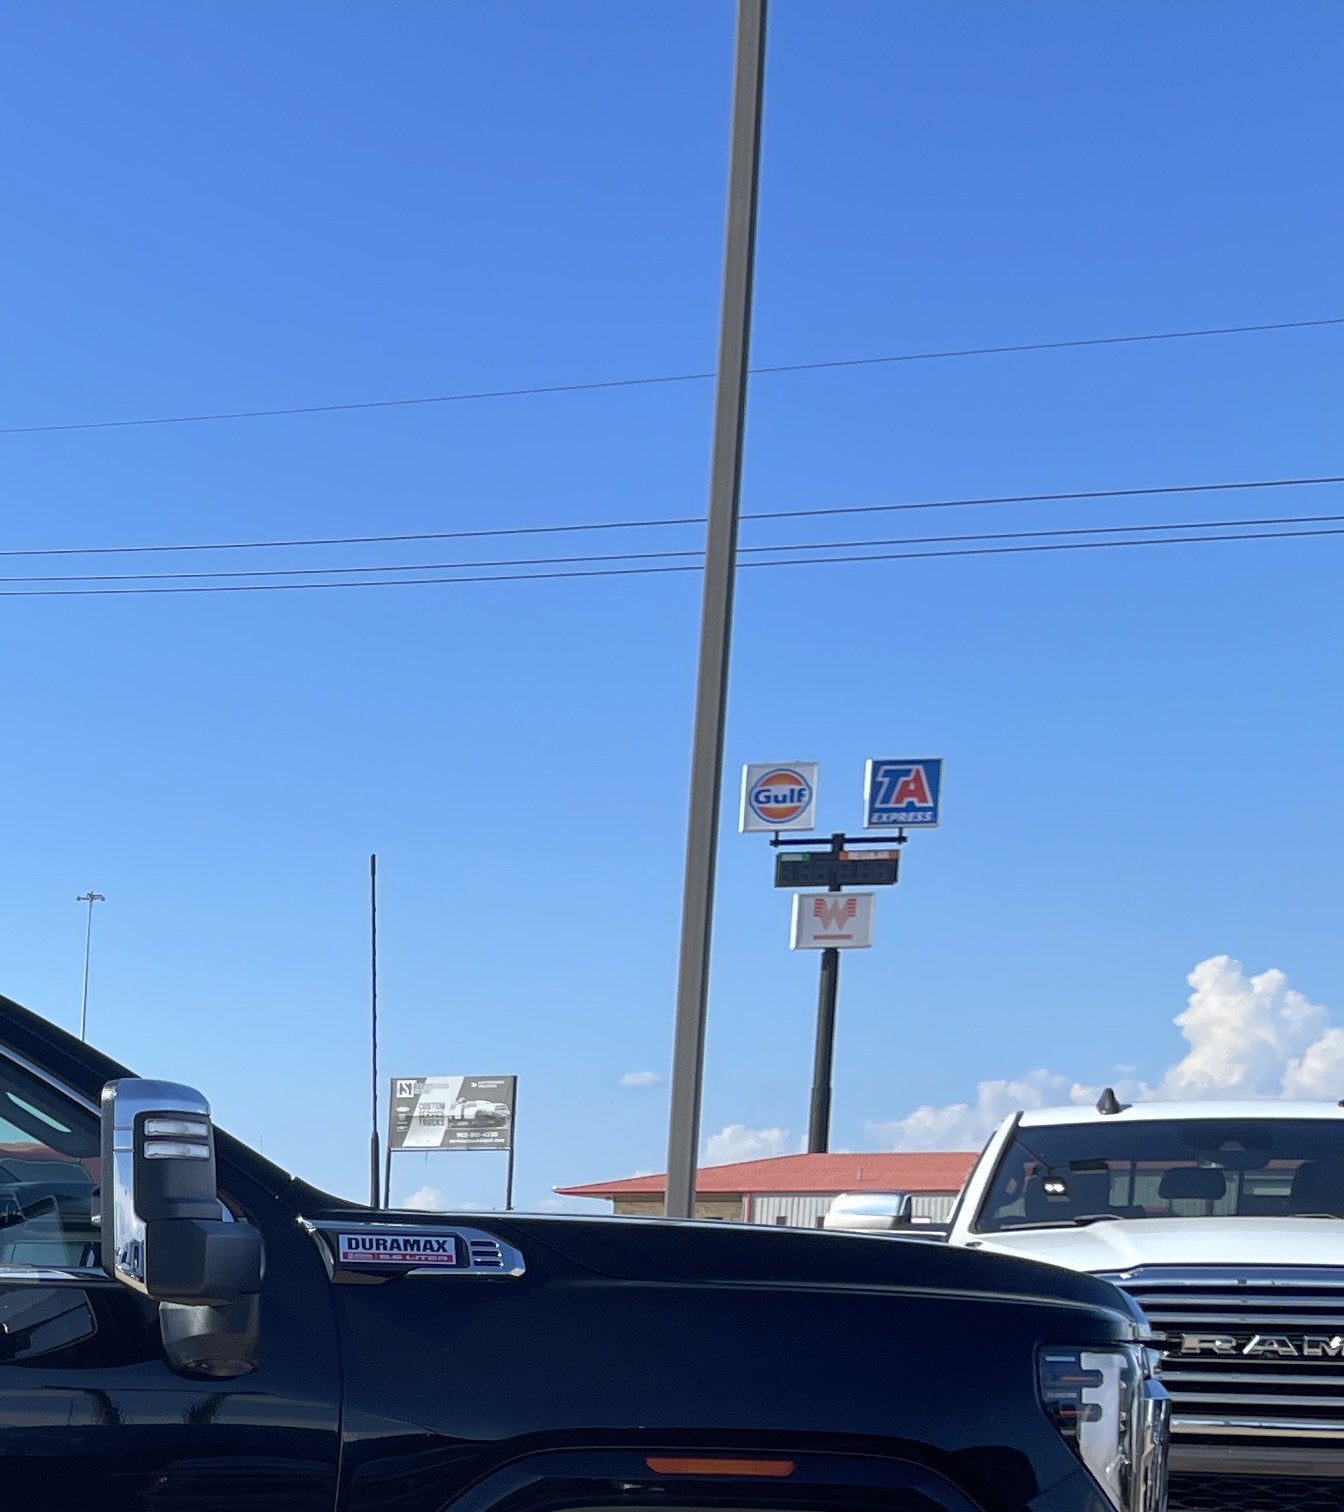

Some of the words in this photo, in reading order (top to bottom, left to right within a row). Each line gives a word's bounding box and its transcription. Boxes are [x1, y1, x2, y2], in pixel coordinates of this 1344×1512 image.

[875, 765, 934, 808] TA
[754, 787, 807, 805] Gulf
[870, 812, 934, 823] EXPRESS
[347, 1237, 449, 1253] DURAMAX
[1181, 1334, 1344, 1356] RAM
